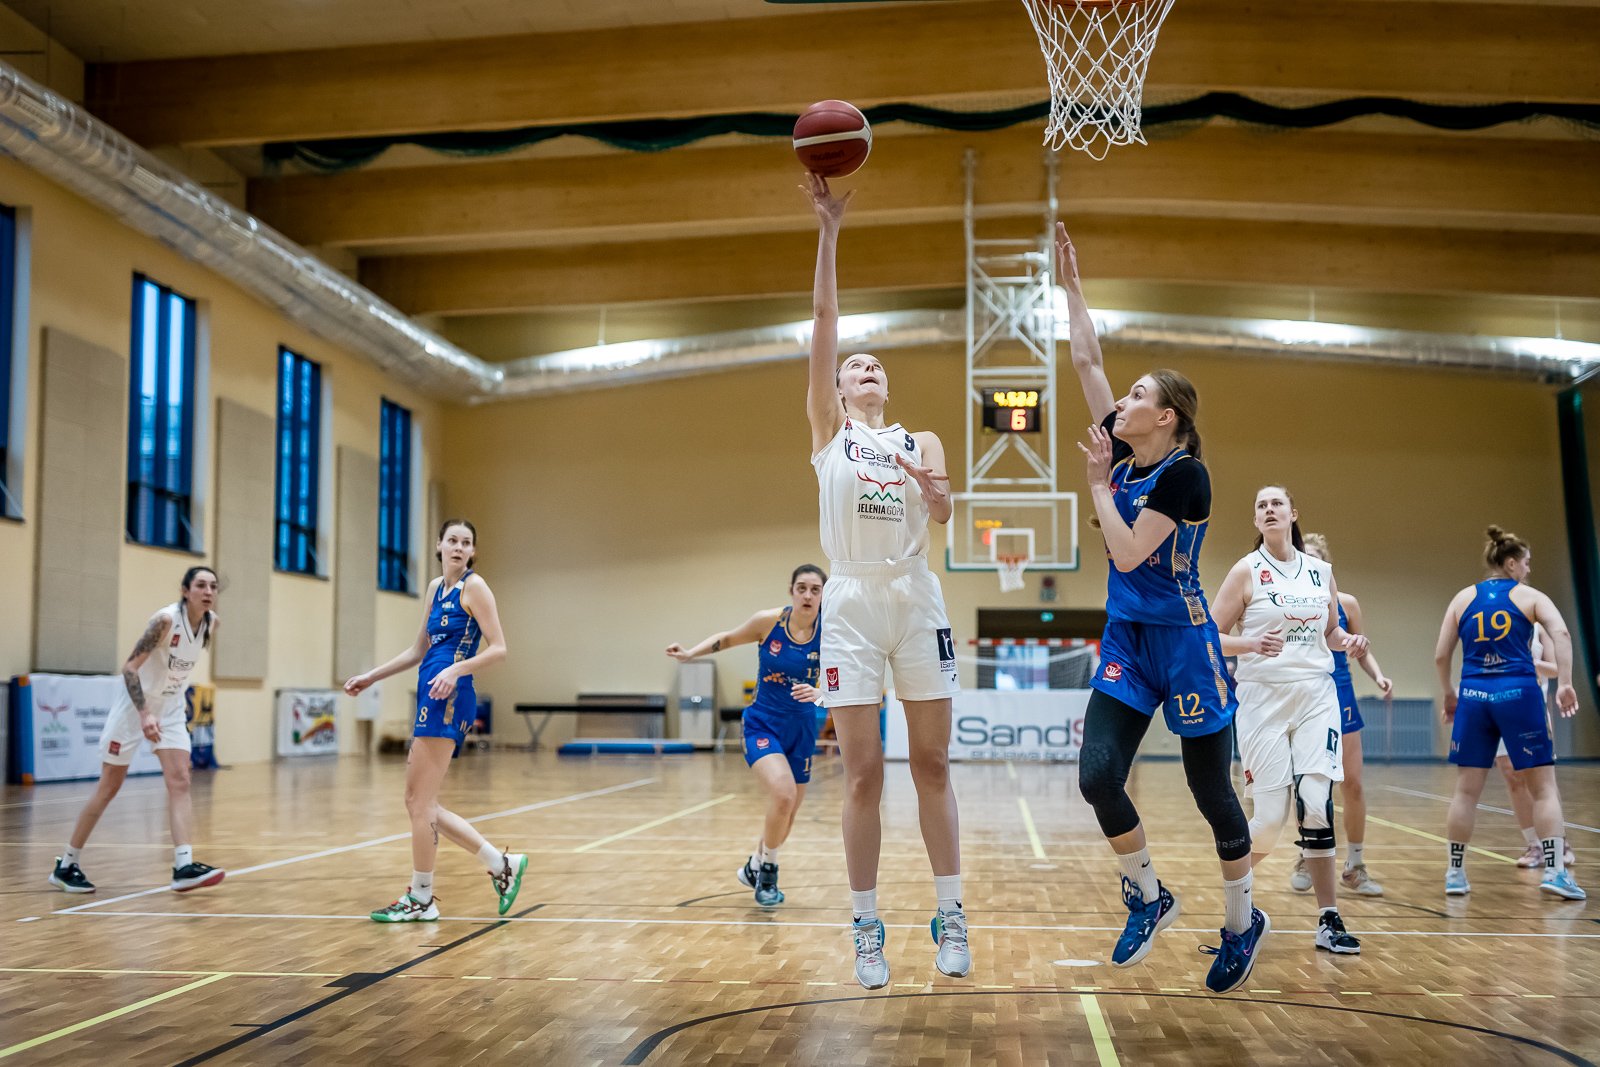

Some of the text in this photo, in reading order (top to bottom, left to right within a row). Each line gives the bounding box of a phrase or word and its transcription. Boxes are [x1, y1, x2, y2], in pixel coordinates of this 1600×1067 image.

[1010, 408, 1027, 431] 6
[904, 433, 915, 452] 9
[857, 503, 886, 515] JELENIA
[1308, 569, 1321, 587] 13
[440, 615, 449, 627] 8
[1471, 610, 1512, 642] 19
[806, 667, 819, 679] 13
[1174, 693, 1205, 717] 12
[419, 706, 428, 723] 8
[1343, 707, 1352, 721] 7
